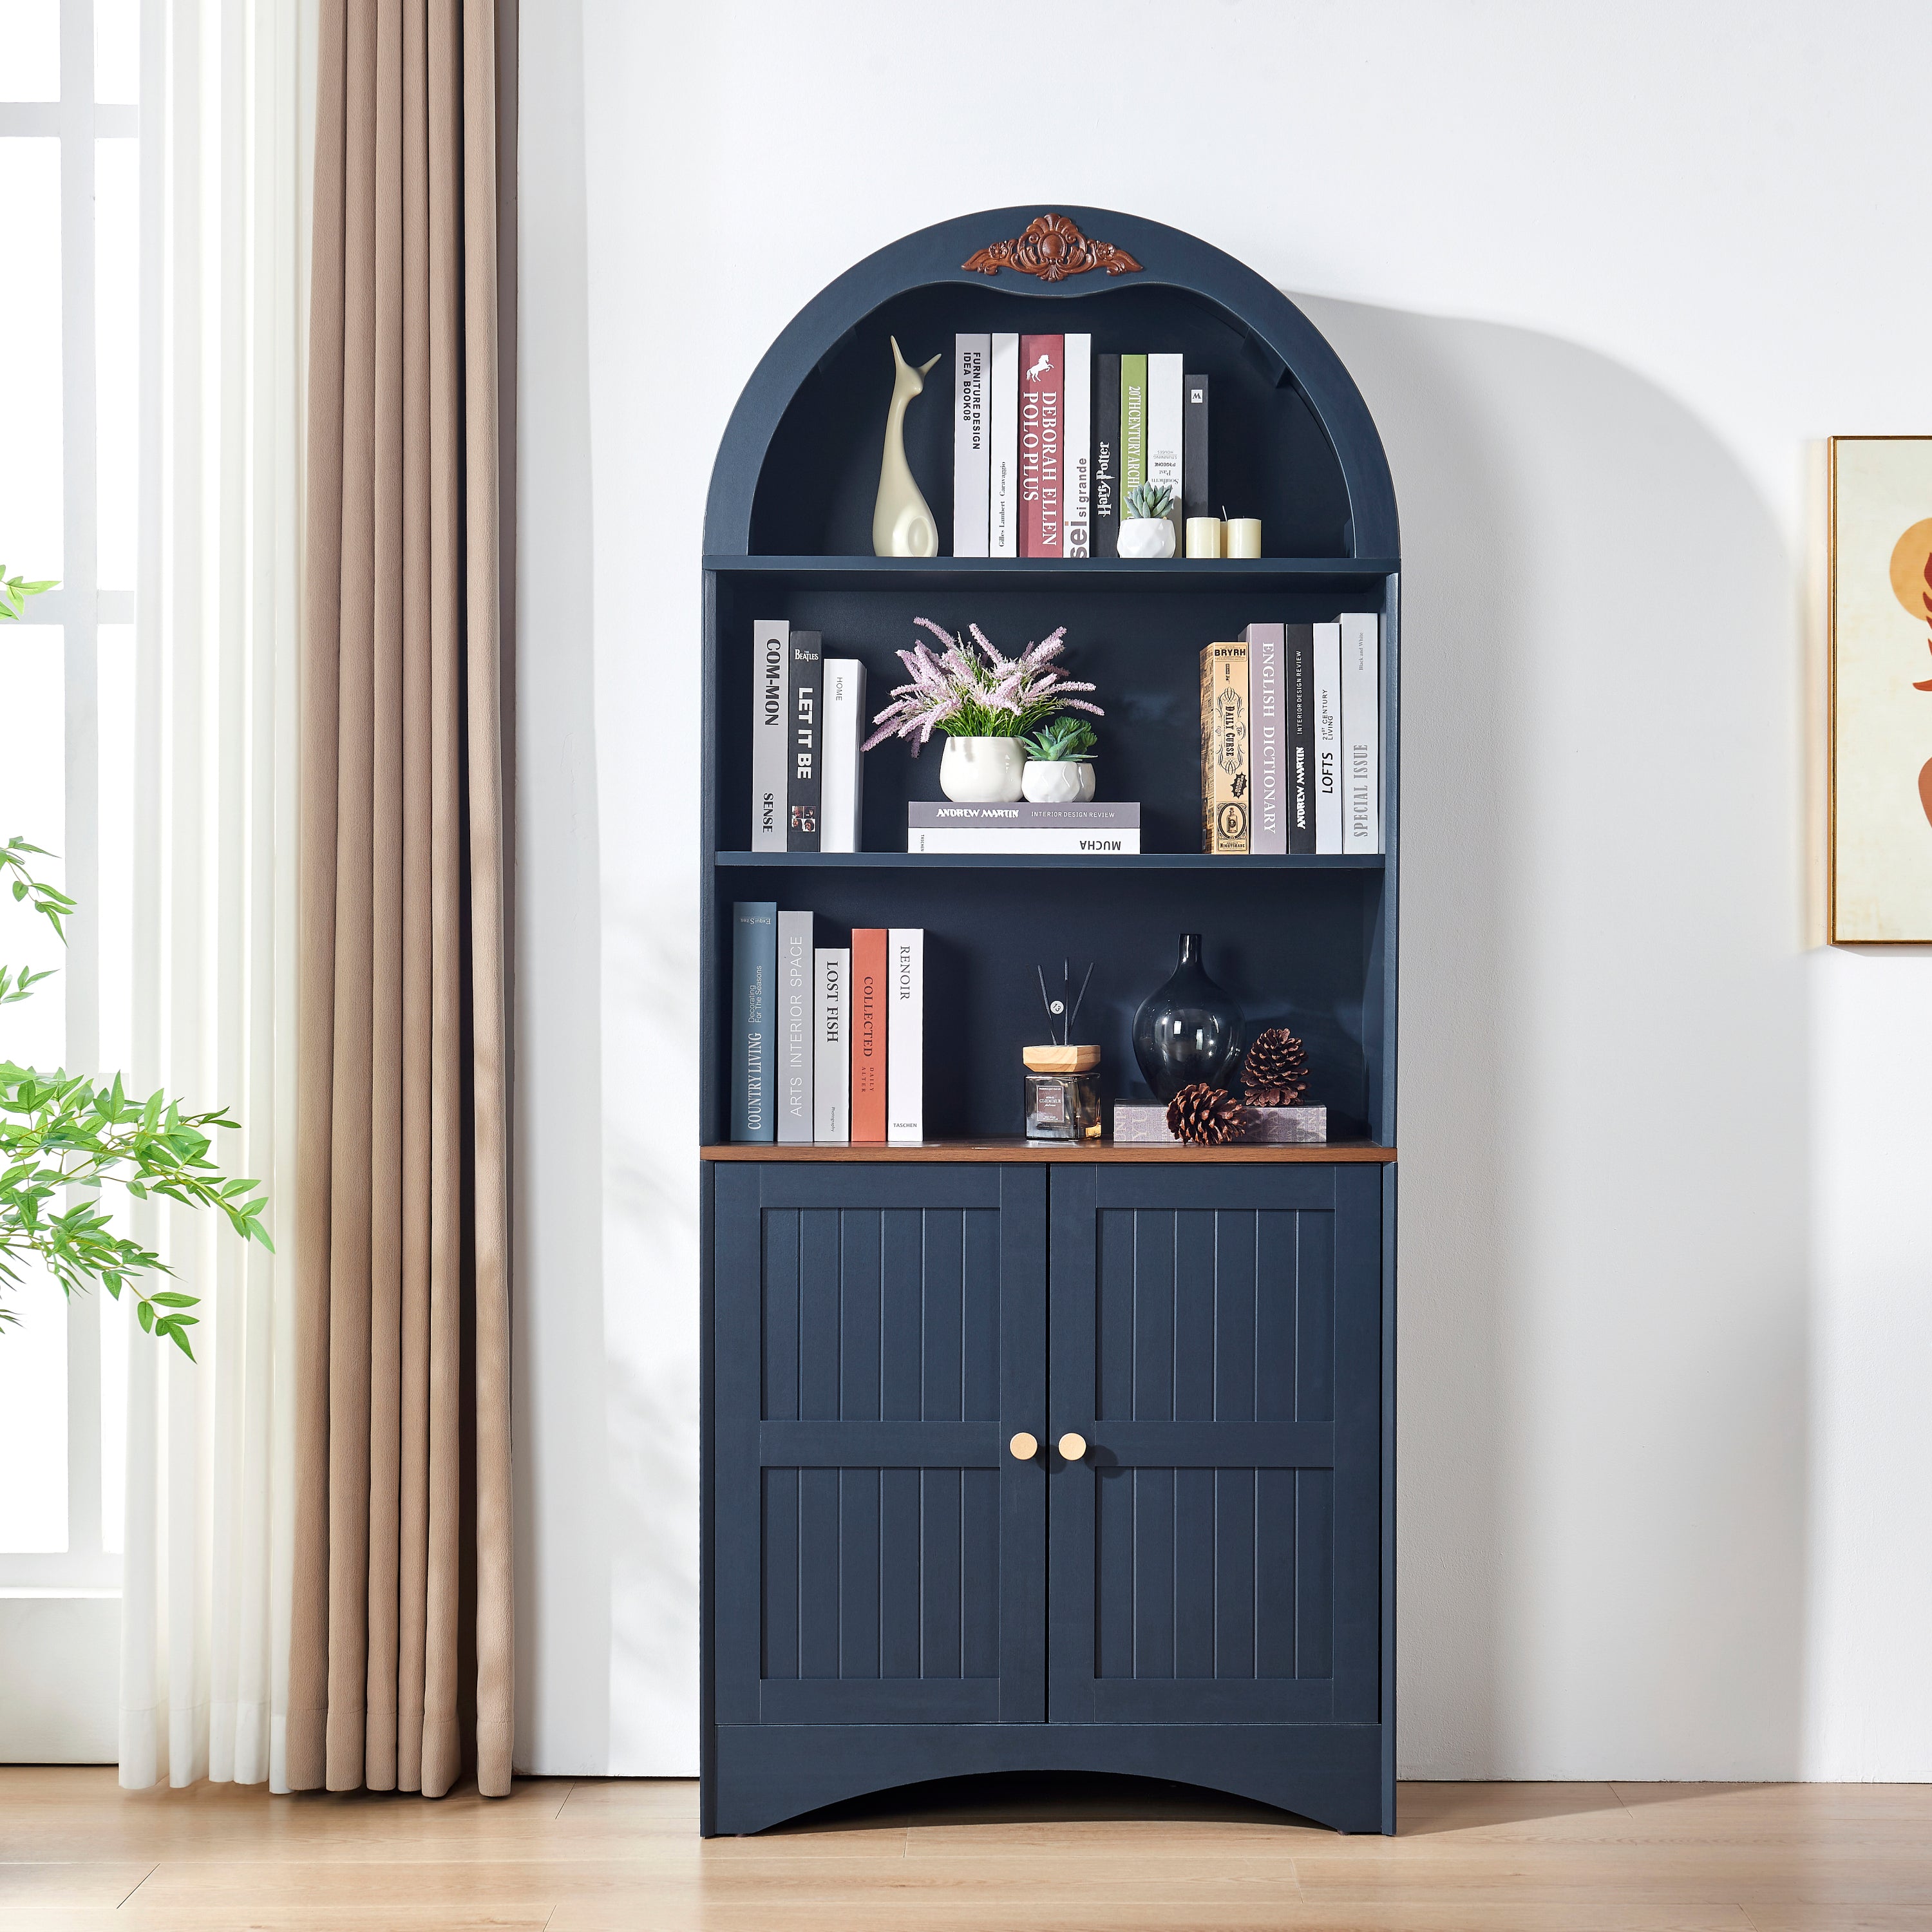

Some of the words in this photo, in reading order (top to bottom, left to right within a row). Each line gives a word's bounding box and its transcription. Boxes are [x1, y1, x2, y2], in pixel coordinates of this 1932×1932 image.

[972, 352, 981, 410] FURNITURE
[972, 412, 981, 450] DESIGN
[1042, 392, 1057, 481] DEBORAH
[999, 461, 1007, 497] Caravaggio
[1077, 458, 1090, 503] grande
[1096, 441, 1115, 480] Potter
[1042, 487, 1057, 545] ELLEN
[1077, 507, 1086, 517] si
[1097, 480, 1112, 518] Harry
[795, 649, 819, 662] BEATLES
[765, 638, 781, 726] COM-MON
[1262, 642, 1275, 718] ENGLISH
[799, 687, 813, 724] LET
[1225, 706, 1235, 730] DAILY
[798, 730, 812, 748] IT
[1226, 732, 1235, 756] CURSE
[797, 753, 812, 779] BE
[1262, 726, 1276, 834] DICTIONARY
[1296, 746, 1305, 785] MARTIN
[1322, 752, 1333, 794] LOFTS
[1353, 744, 1368, 779] ISSUE
[762, 793, 774, 833] SENSE
[936, 808, 980, 818] ANDREW
[981, 809, 1019, 819] MARTIN
[1296, 785, 1306, 830] ANDREW
[1354, 785, 1368, 837] SPECIAL
[1079, 840, 1121, 851] MUCHA
[790, 936, 802, 987] SPACE
[826, 960, 838, 1001] LOST
[900, 945, 910, 1000] RENOIR
[748, 984, 757, 1023] Decorating
[863, 976, 873, 1057] COLLECTED
[1053, 1003, 1061, 1012] 13
[790, 994, 802, 1068] INTERIOR
[826, 1007, 838, 1043] FISH
[747, 1032, 762, 1074] LIVING
[747, 1075, 762, 1130] COUNTRY
[790, 1076, 802, 1117] ARTS
